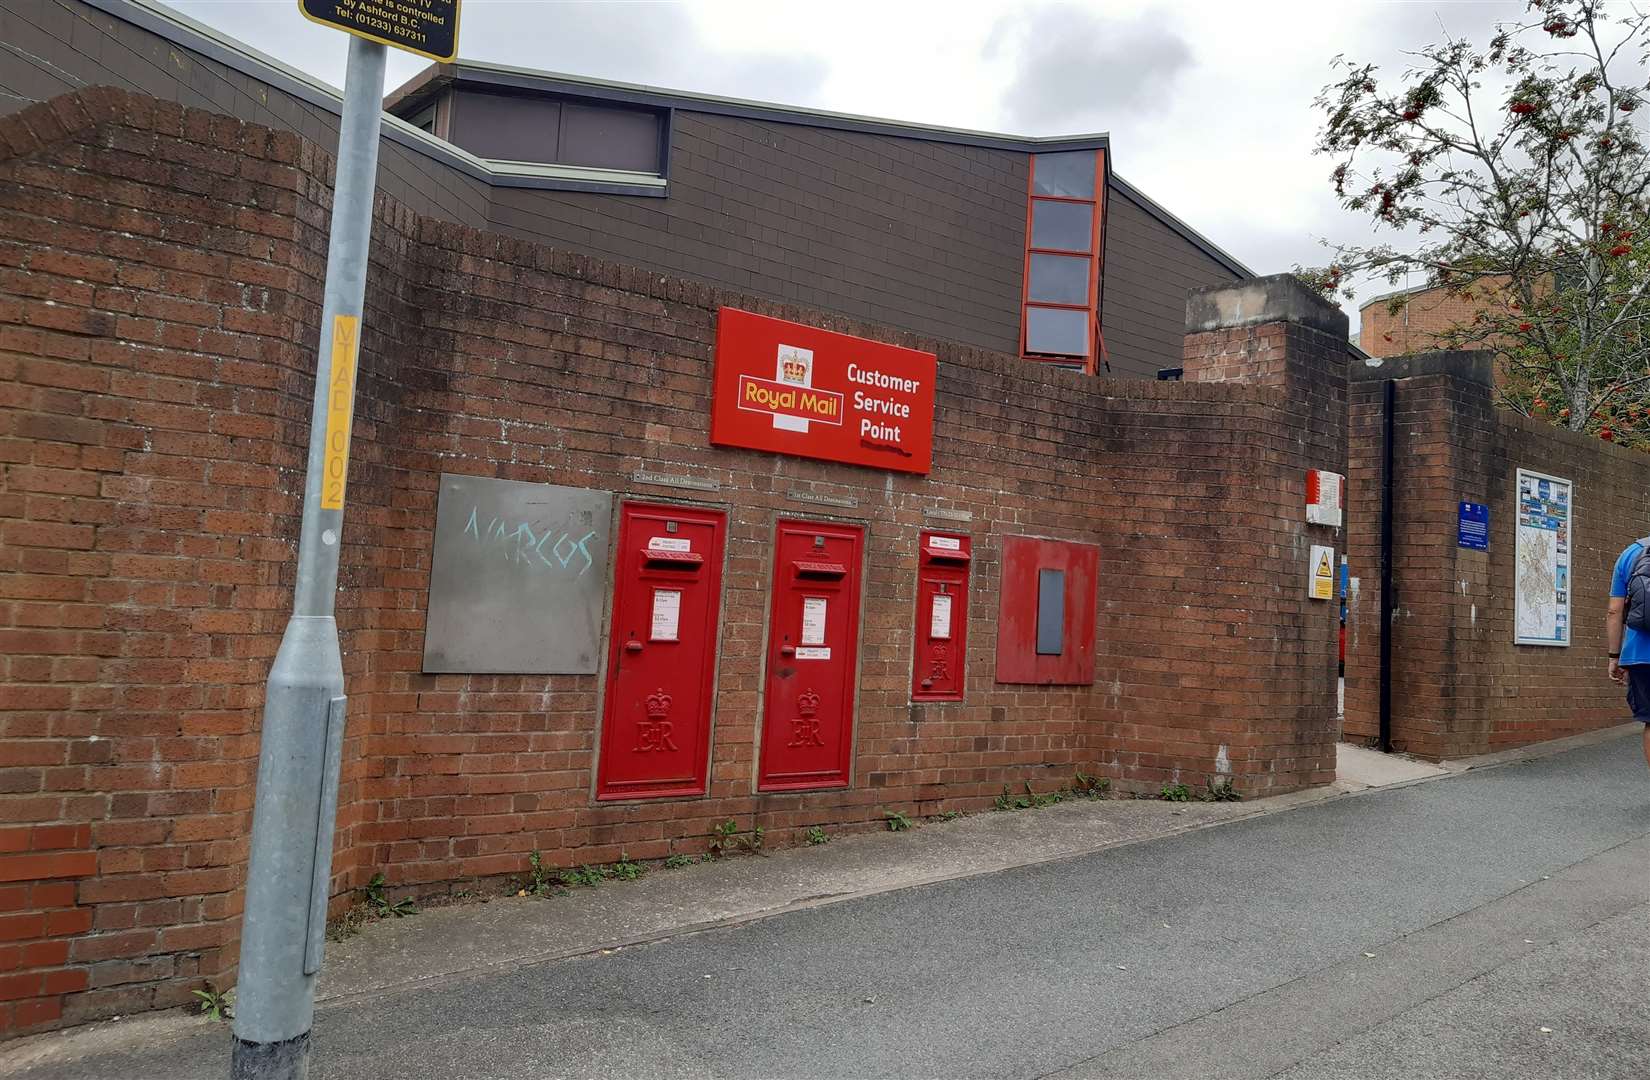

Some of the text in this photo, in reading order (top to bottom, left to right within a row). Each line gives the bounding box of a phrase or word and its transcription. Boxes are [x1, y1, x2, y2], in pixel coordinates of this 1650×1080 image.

[335, 5, 426, 43] Tel: (01233) 637311
[359, 2, 398, 22] Ashford
[400, 15, 420, 30] B.C.
[396, 3, 445, 25] controlled
[847, 363, 920, 393] Customer
[745, 382, 837, 416] Royal Mail
[853, 391, 910, 418] Service
[860, 418, 901, 442] Point
[328, 431, 345, 504] 002
